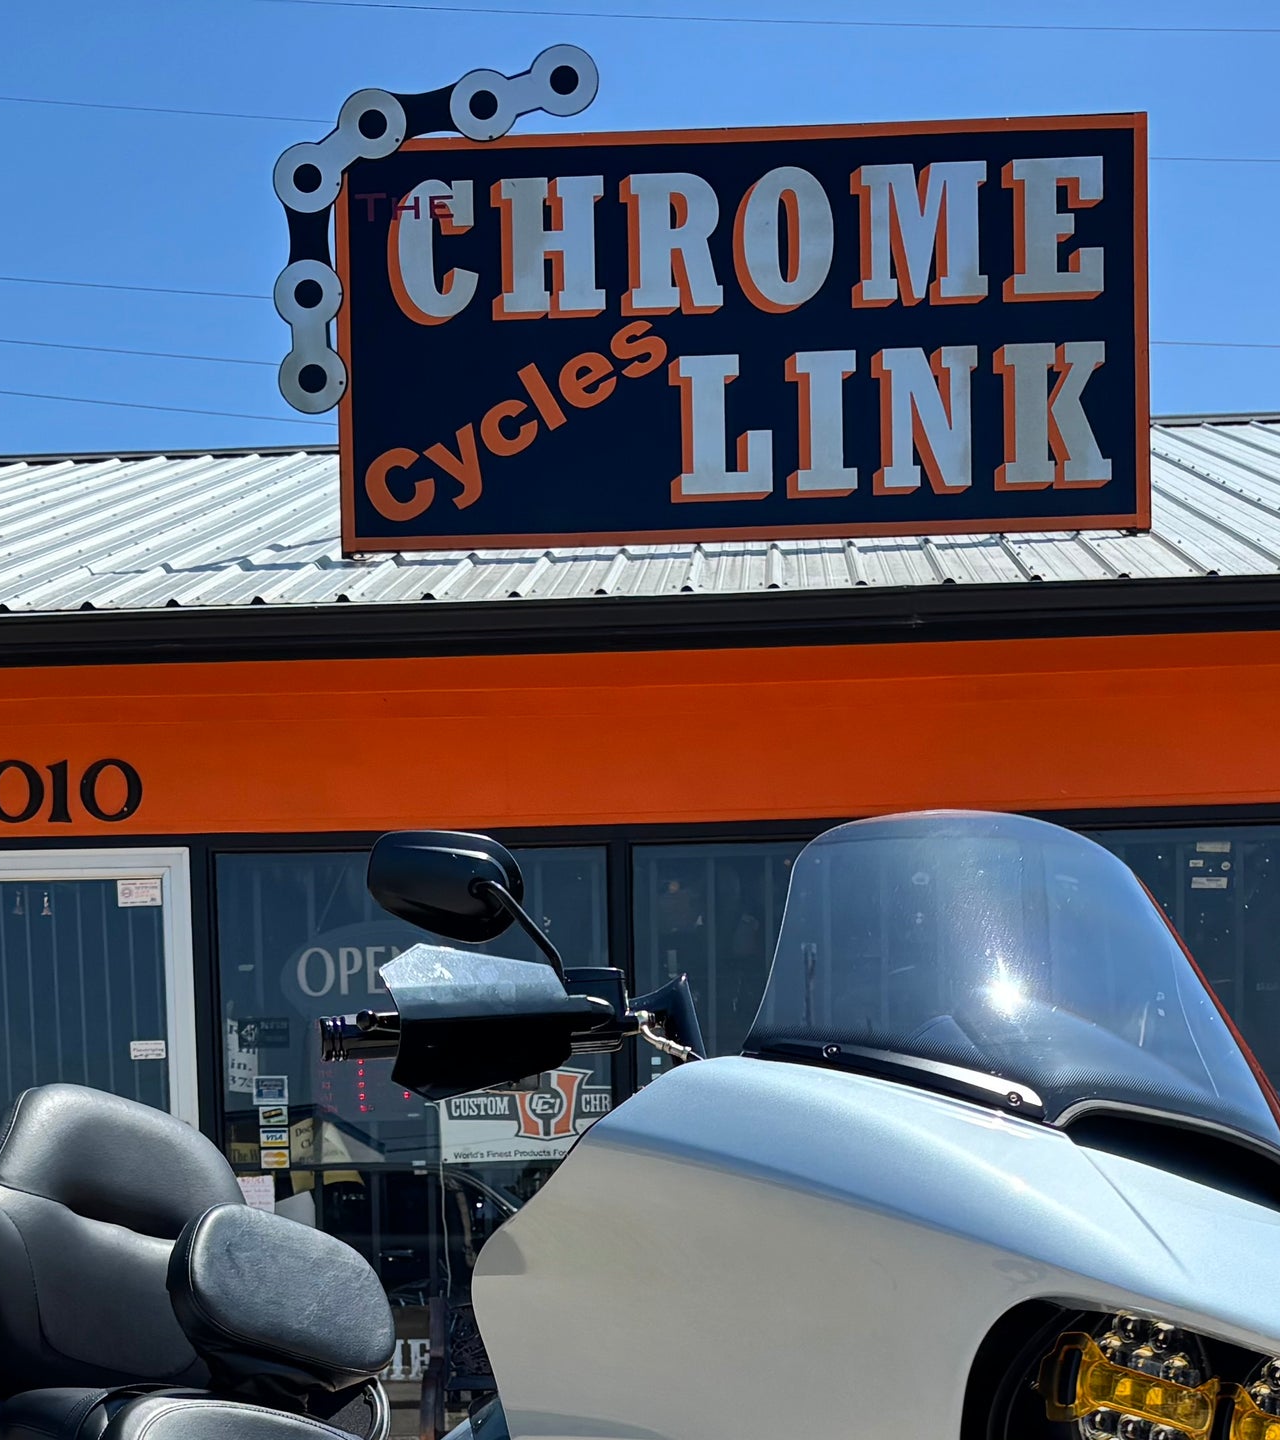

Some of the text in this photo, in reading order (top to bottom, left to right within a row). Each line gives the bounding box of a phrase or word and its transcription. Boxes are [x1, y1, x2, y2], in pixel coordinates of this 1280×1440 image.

[388, 155, 1105, 326] CHROME
[365, 319, 668, 522] Cycles
[671, 340, 1112, 503] LINK
[297, 946, 403, 997] OPE
[451, 1093, 510, 1117] CUSTOM
[581, 1093, 612, 1113] CHR
[454, 1151, 484, 1160] World's
[486, 1150, 511, 1159] Finest
[514, 1149, 551, 1158] Products
